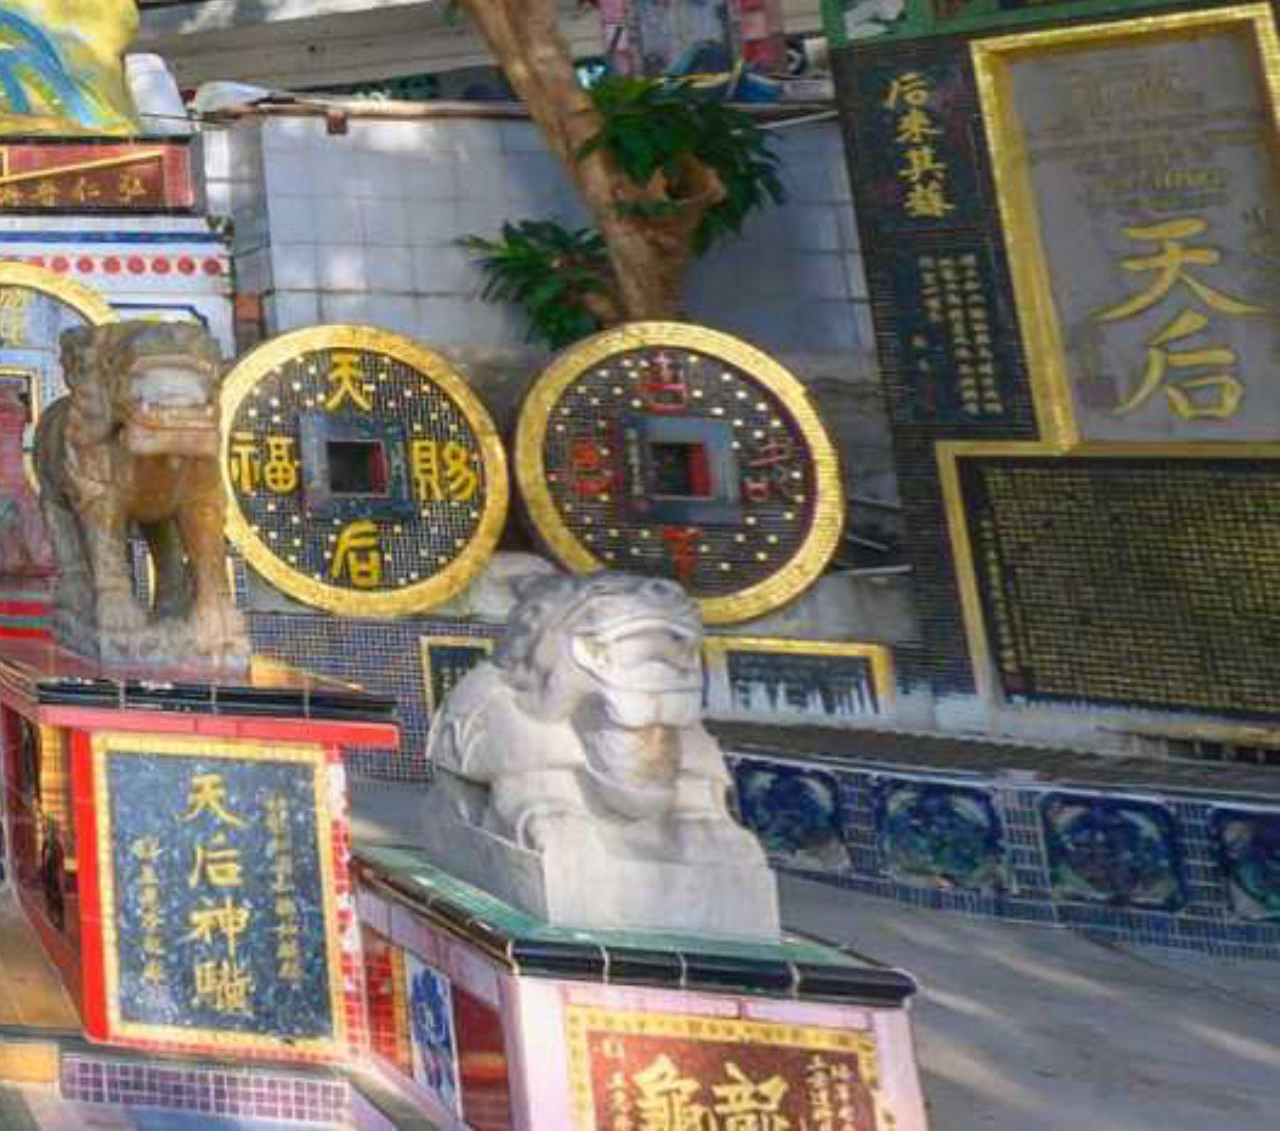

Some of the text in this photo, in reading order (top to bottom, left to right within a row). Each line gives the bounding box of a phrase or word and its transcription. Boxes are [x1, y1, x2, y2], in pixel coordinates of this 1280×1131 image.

[1092, 217, 1267, 421] 天后
[325, 351, 373, 413] 天
[230, 431, 298, 495] 福
[331, 520, 381, 591] 后
